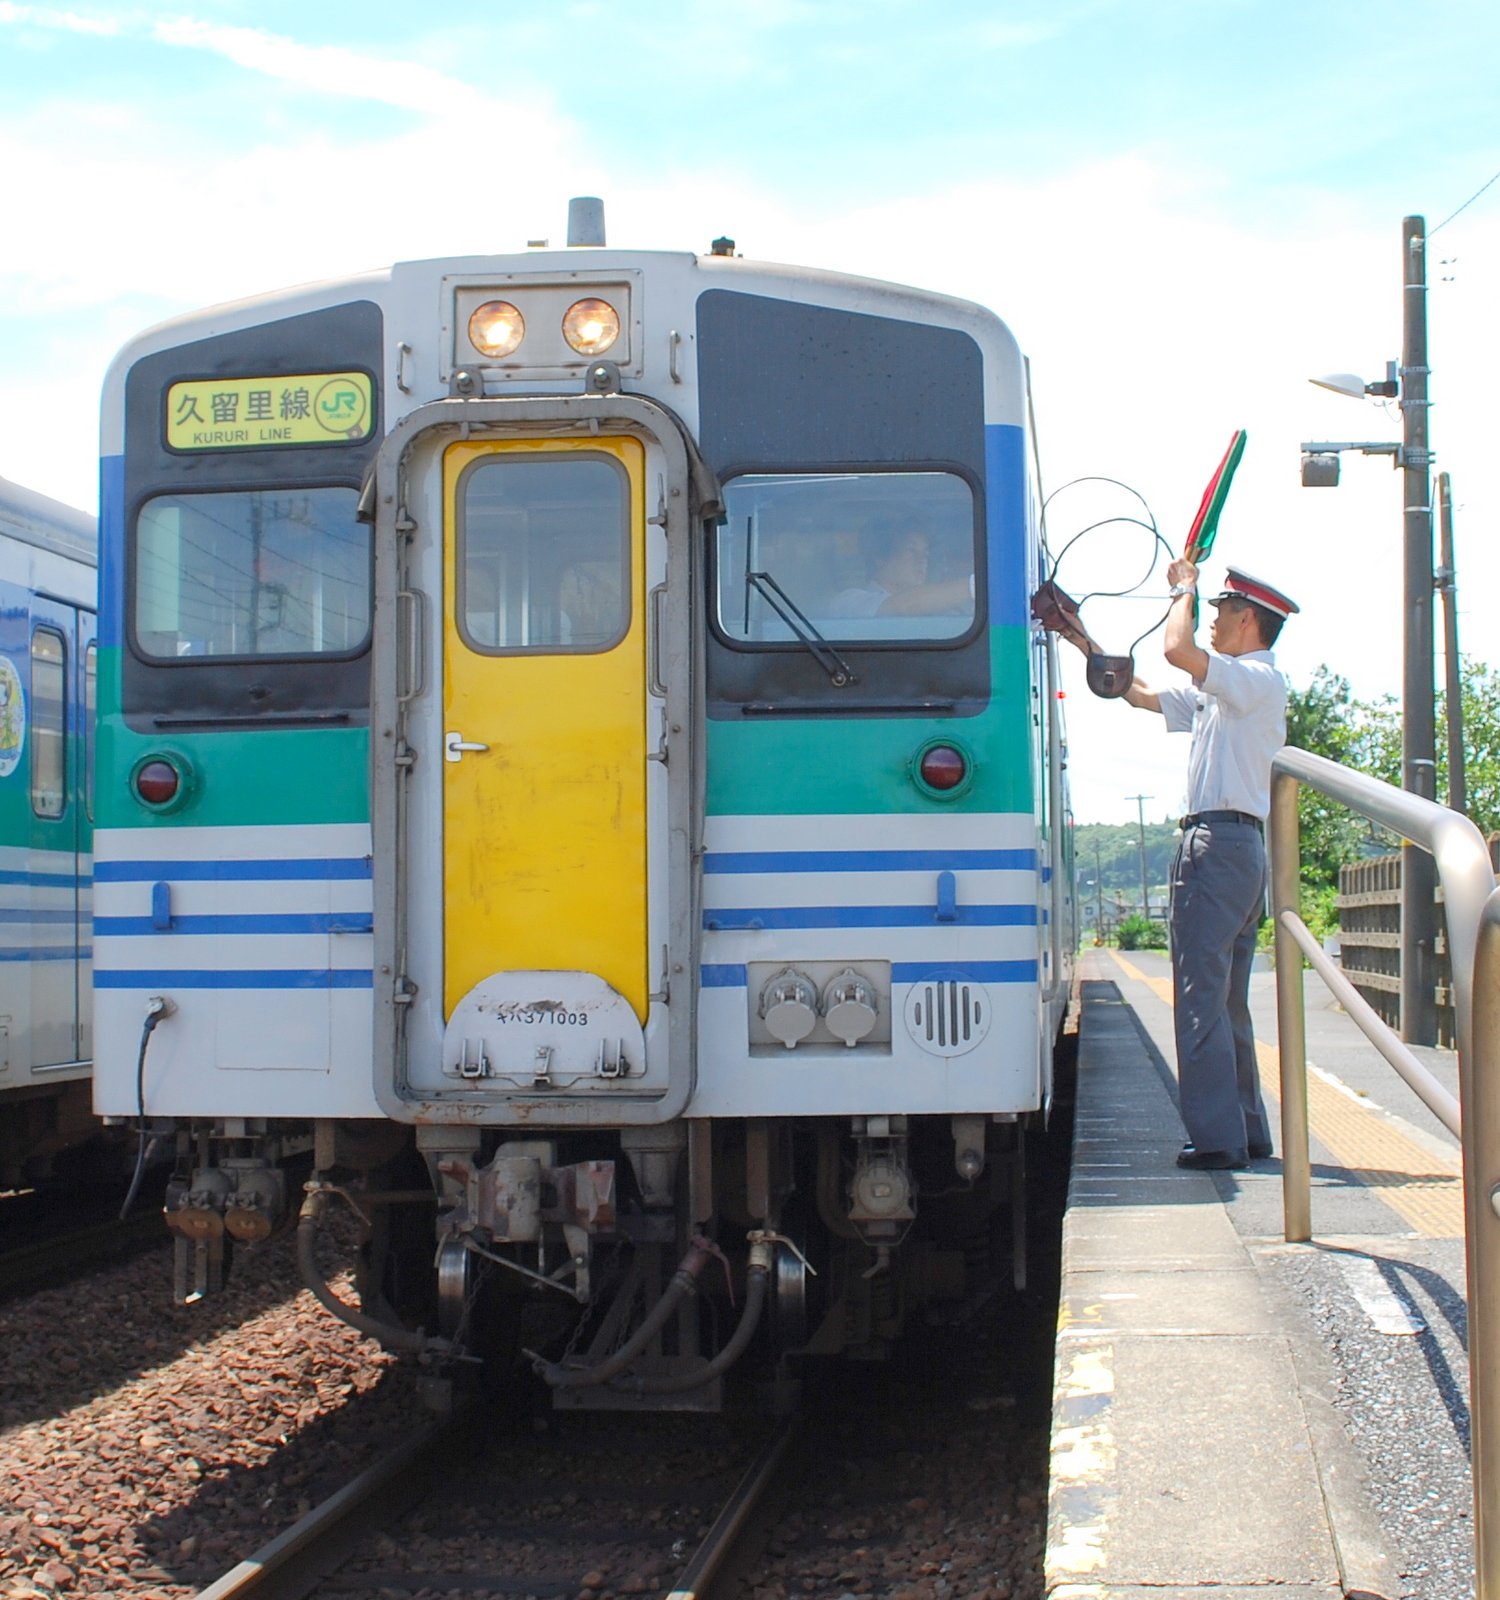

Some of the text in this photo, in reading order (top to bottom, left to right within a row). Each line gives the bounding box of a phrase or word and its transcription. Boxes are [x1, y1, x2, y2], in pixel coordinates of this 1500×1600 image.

[176, 387, 312, 426] 久留里線
[321, 391, 357, 413] JR
[193, 427, 292, 444] KURURI LINE
